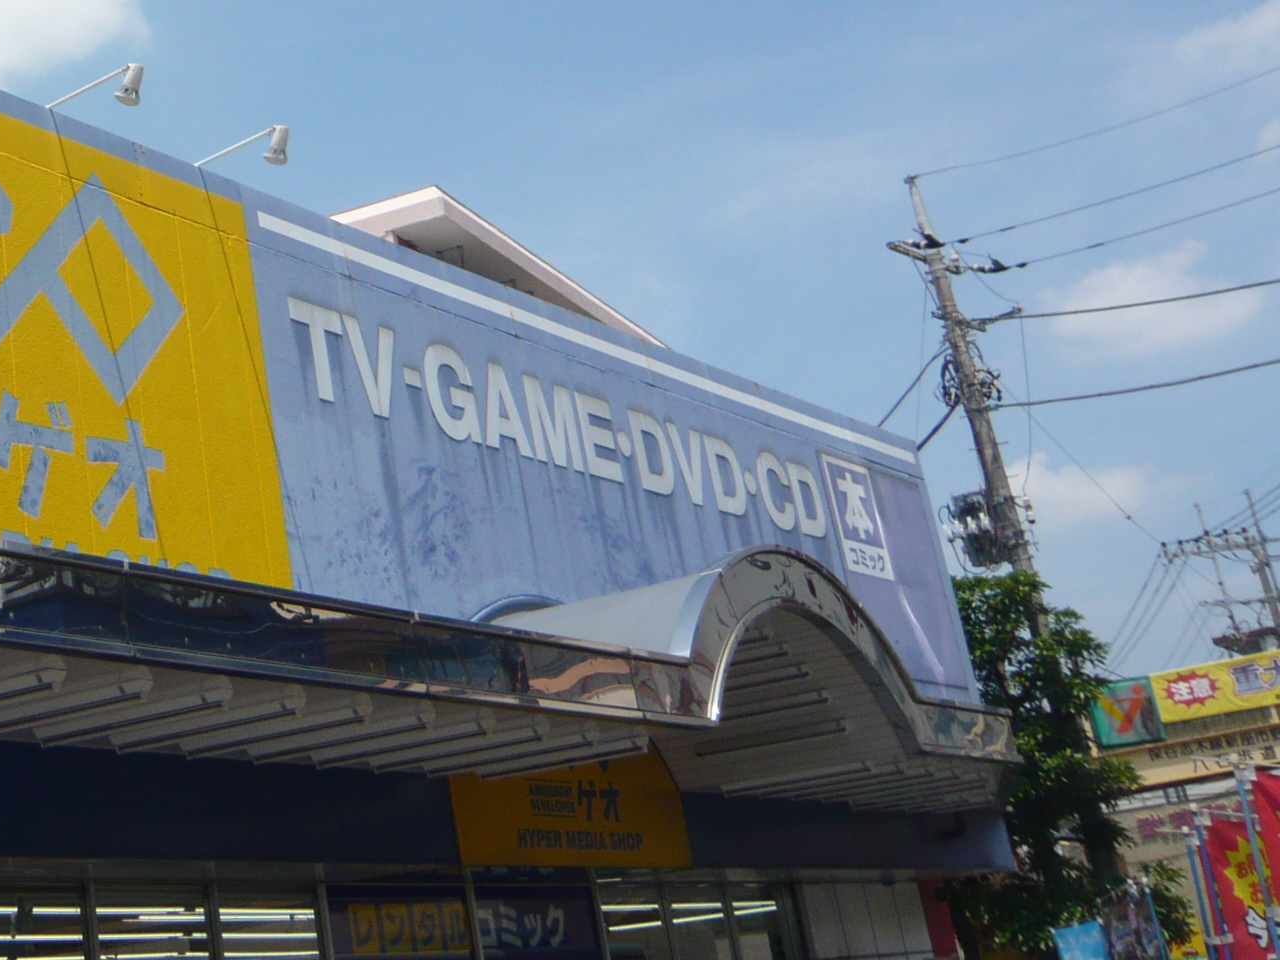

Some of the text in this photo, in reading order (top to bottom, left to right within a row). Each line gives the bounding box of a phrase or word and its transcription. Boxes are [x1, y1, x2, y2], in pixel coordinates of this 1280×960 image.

[836, 471, 874, 540] 本
[849, 547, 886, 573] コミック
[577, 779, 620, 823] ゲオ
[517, 828, 644, 851] HYPER MEDIA SHOP
[353, 904, 566, 948] レンタル コミック
